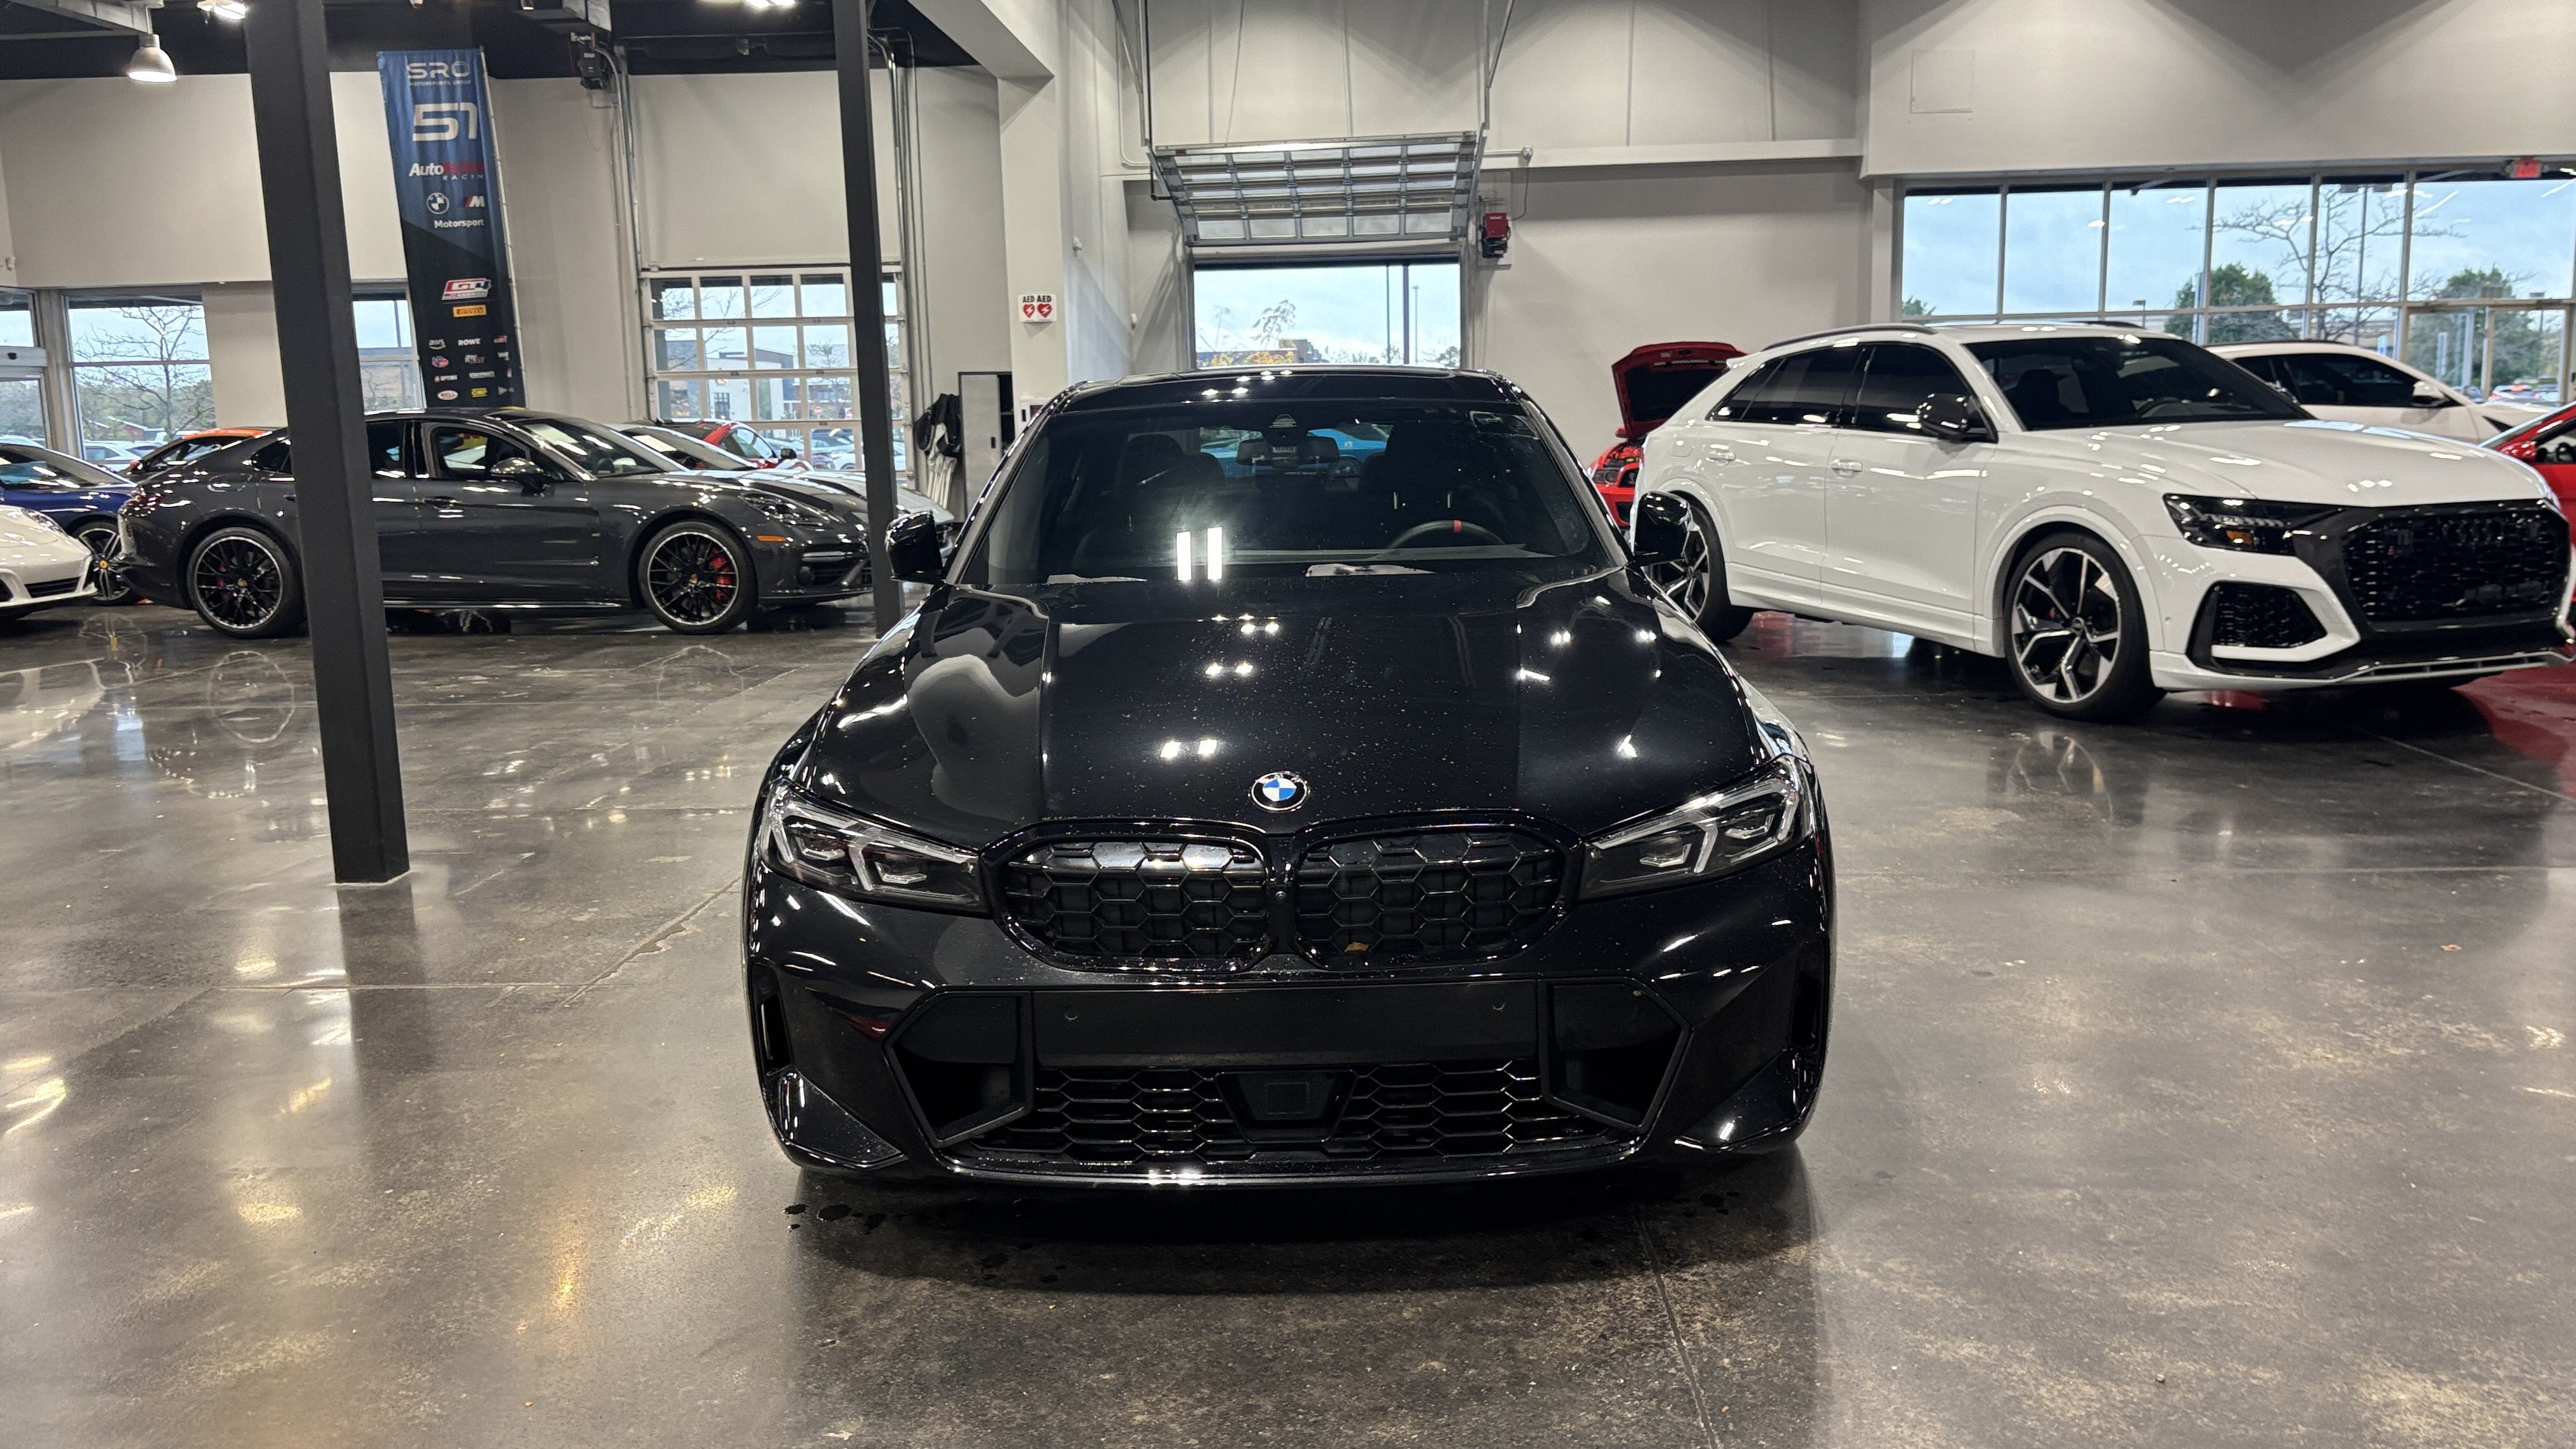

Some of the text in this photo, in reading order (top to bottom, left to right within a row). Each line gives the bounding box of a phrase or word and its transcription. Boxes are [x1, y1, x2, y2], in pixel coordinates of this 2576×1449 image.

[408, 61, 471, 79] SRO
[412, 102, 478, 142] 51
[434, 218, 484, 229] Motorsport
